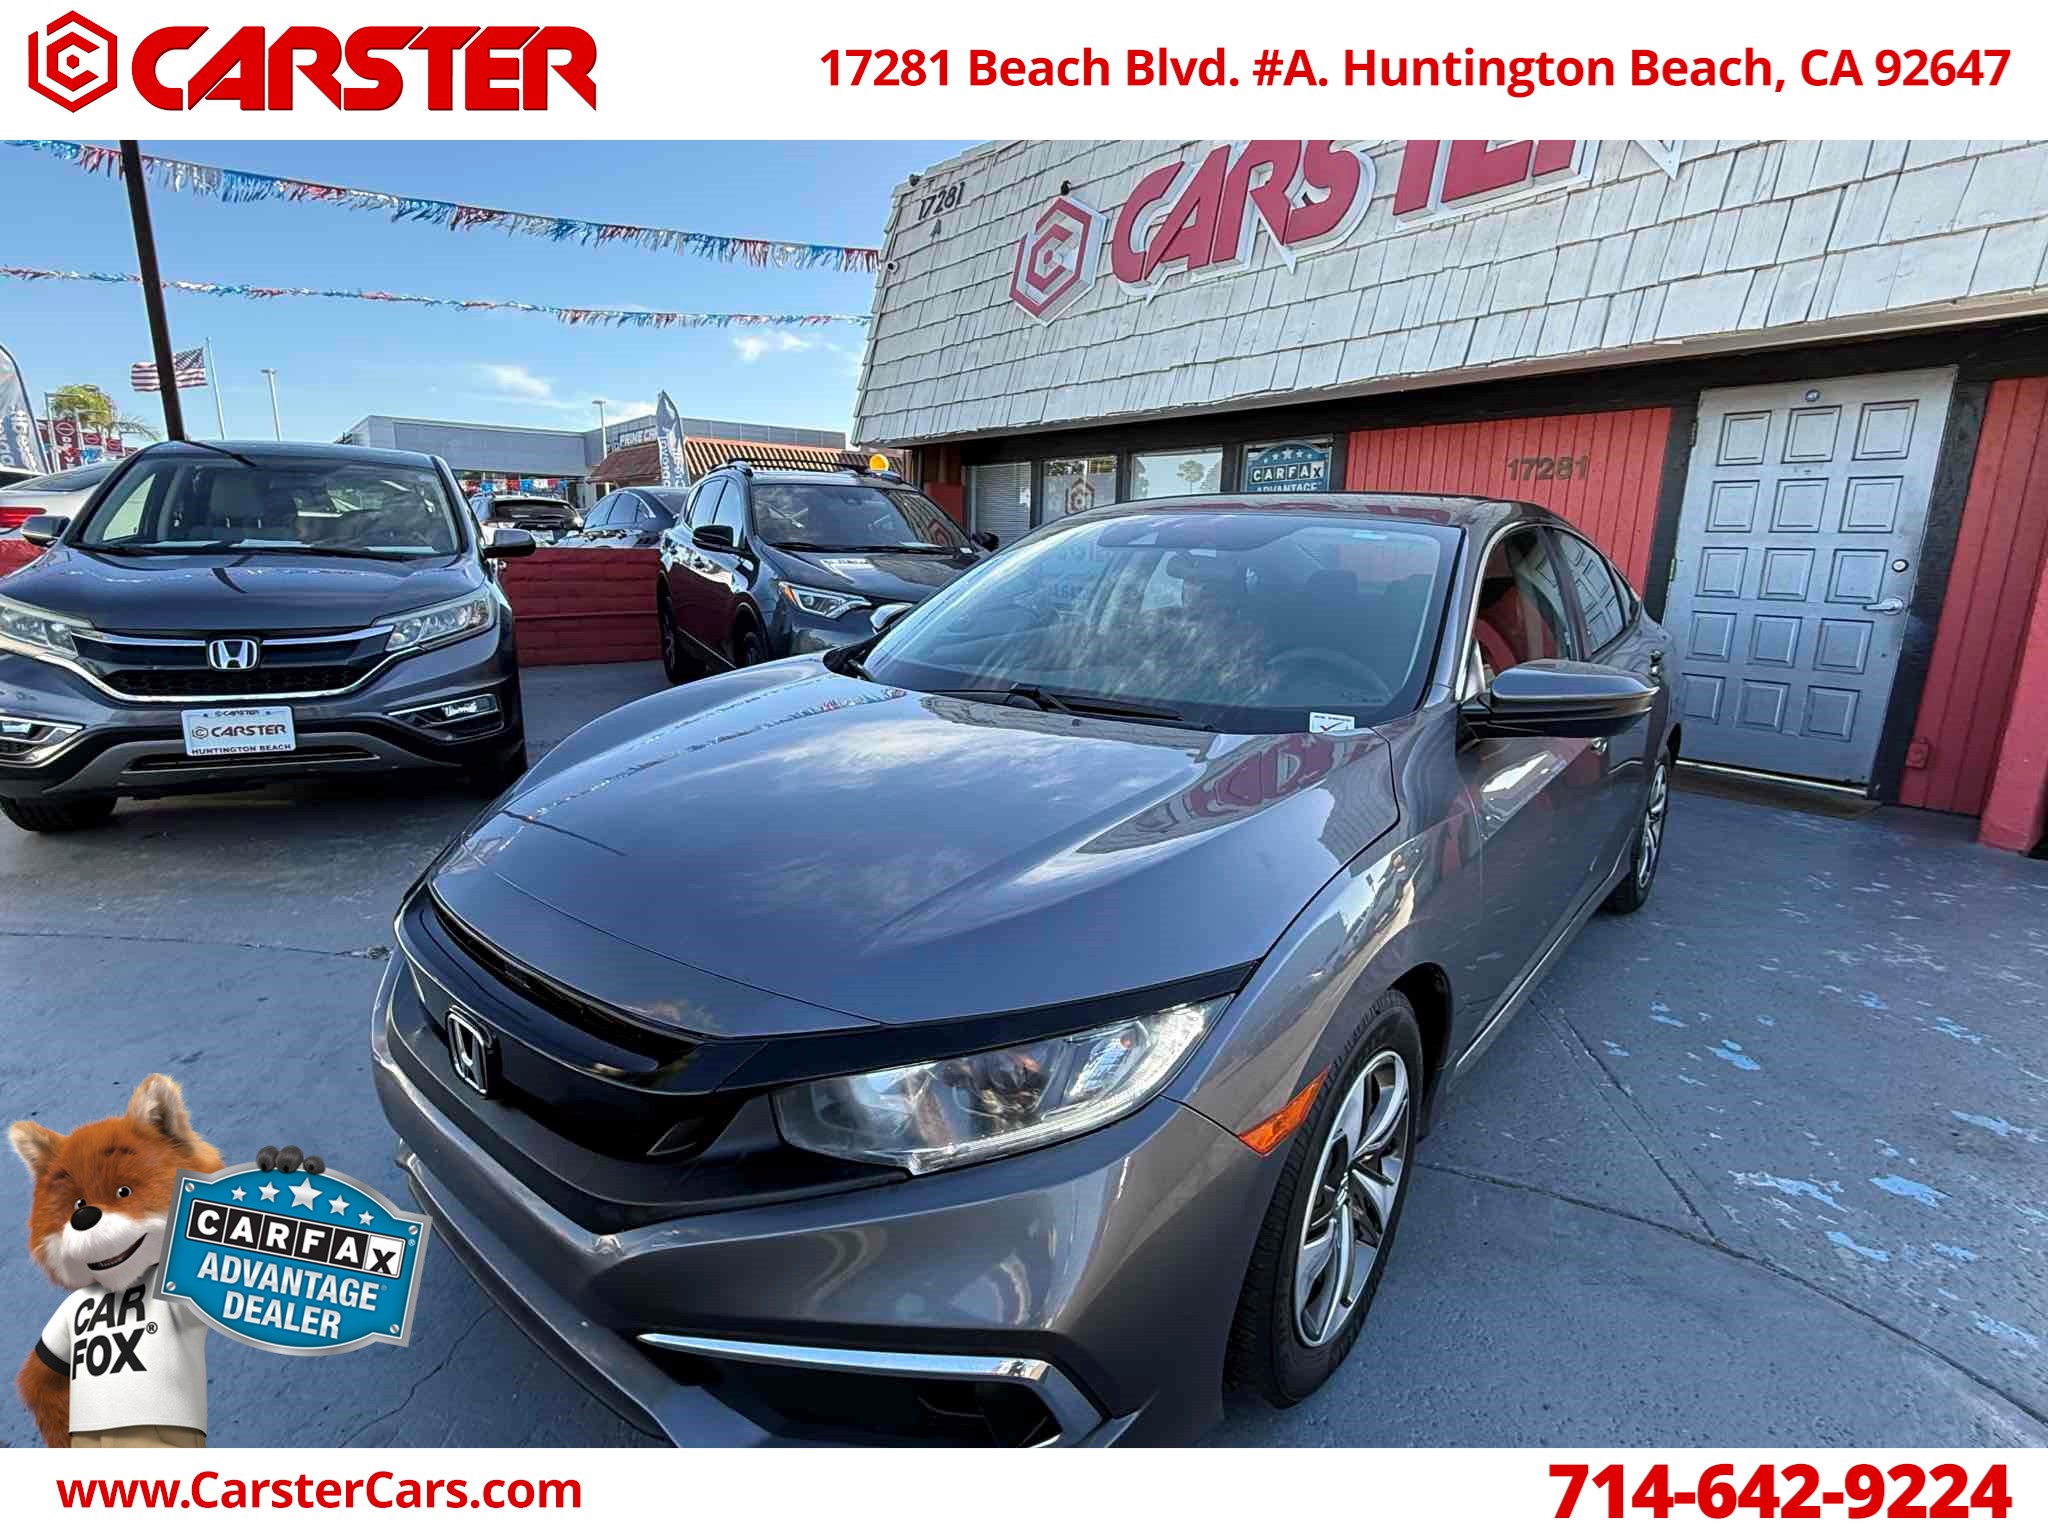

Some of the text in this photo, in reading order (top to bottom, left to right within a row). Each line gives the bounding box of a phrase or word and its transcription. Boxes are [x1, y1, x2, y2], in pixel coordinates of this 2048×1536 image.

[918, 182, 966, 221] 17281
[1109, 140, 1580, 286] CARST
[1252, 463, 1322, 482] CARFAX
[1508, 456, 1589, 481] 17281
[211, 724, 287, 738] CARSTER
[191, 743, 291, 755] HUNTINGTON BEACH
